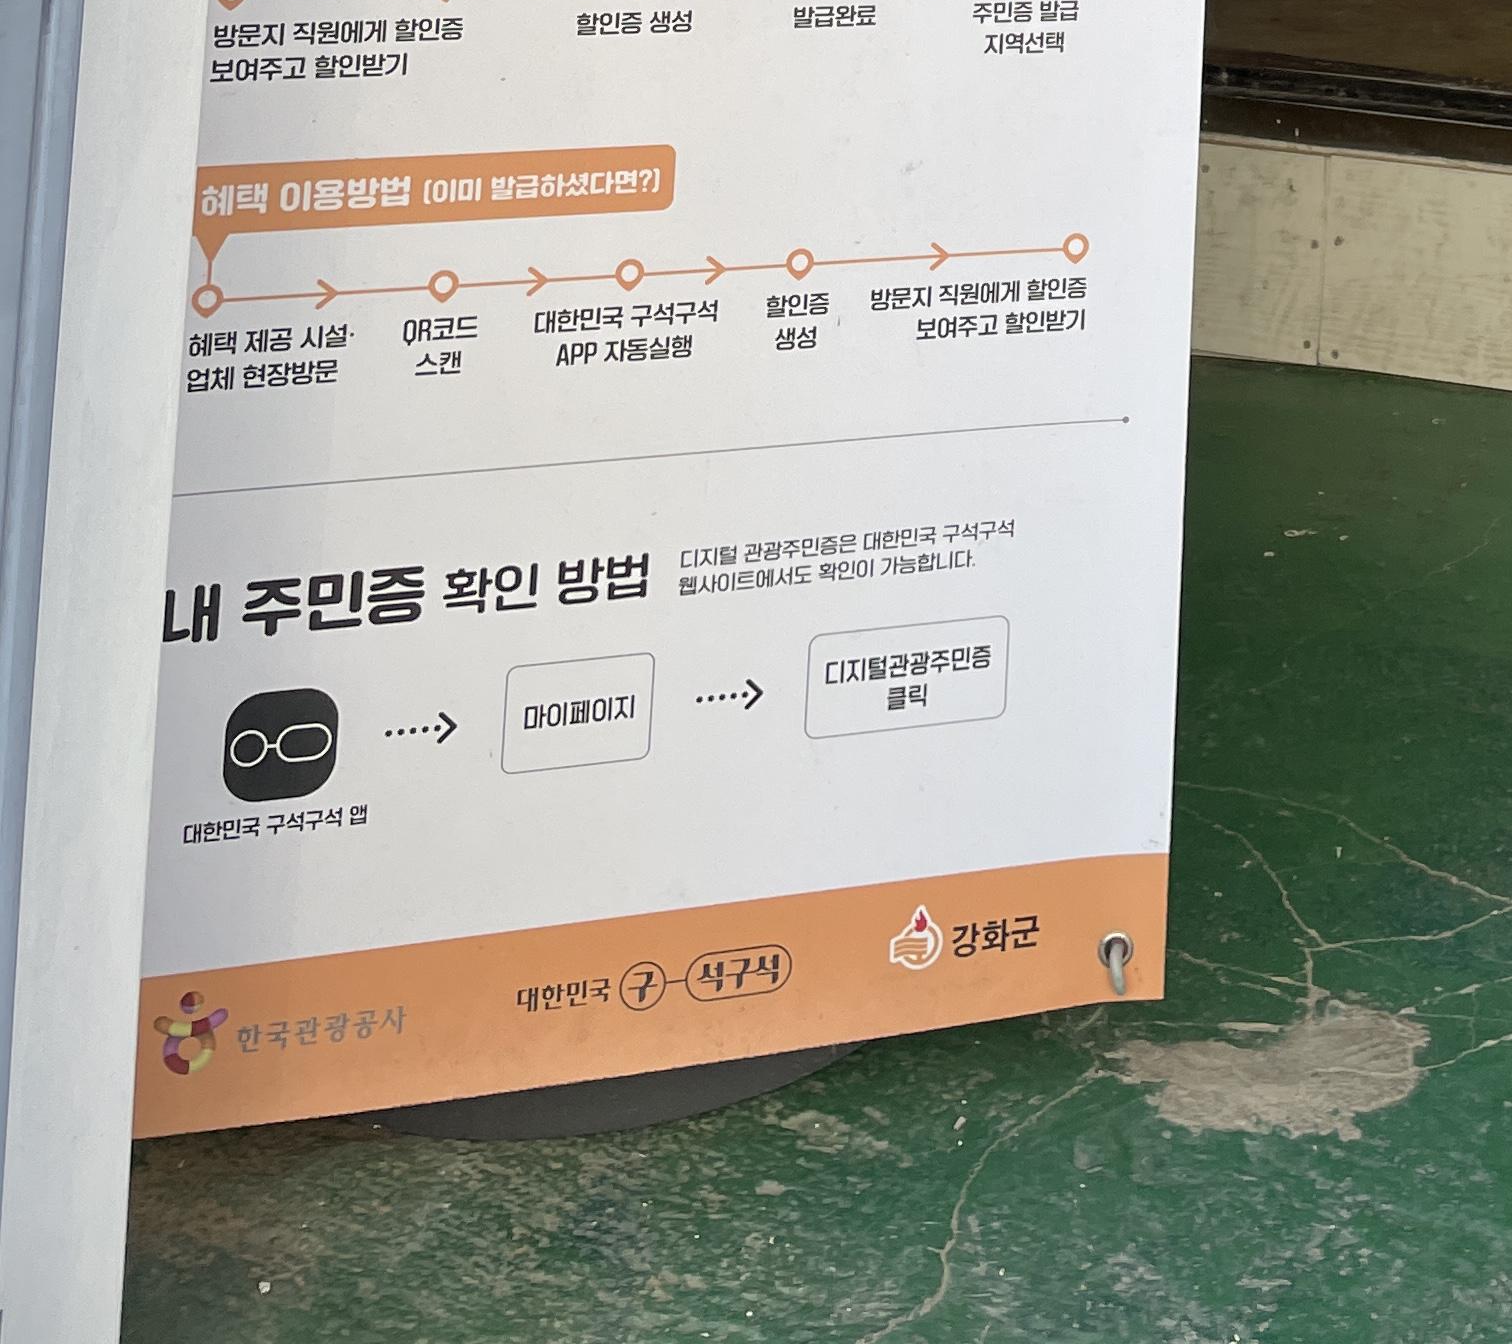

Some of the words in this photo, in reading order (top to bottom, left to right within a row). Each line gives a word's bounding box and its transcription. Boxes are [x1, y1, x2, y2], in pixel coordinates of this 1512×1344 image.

[576, 12, 642, 37] 할인증
[650, 9, 693, 33] 생성
[793, 5, 877, 29] 발급완료
[973, 1, 1033, 23] 주민증
[1039, 0, 1079, 23] 발급
[213, 23, 285, 48] 방문지
[293, 20, 387, 46] 직원에게
[395, 17, 464, 42] 할인증
[984, 32, 1065, 55] 지역선택
[210, 56, 306, 82] 보여주고
[314, 53, 408, 79] 할인받기
[202, 183, 268, 217] 혜택
[279, 176, 410, 212] 이용방법
[766, 292, 830, 318] 할인증
[870, 286, 932, 311] 방문지
[939, 280, 1020, 306] 직원에게
[1027, 277, 1087, 300] 할인증
[402, 315, 478, 346] QR코드
[534, 307, 624, 334] 대한민국
[630, 300, 719, 328] 구석구석
[916, 316, 997, 341] 보여주고
[1005, 309, 1086, 335] 할인받기
[189, 332, 237, 357] 혜택
[244, 328, 293, 353] 제공
[556, 342, 596, 367] APP
[604, 335, 693, 362] 자동실행
[775, 326, 817, 351] 생성
[186, 367, 234, 392] 업체
[243, 360, 338, 389] 현장방문
[414, 351, 462, 377] 스캔
[680, 548, 737, 569] 디지털
[743, 534, 857, 563] 관광주민증은
[863, 528, 937, 551] 대한민국
[942, 519, 1015, 544] 구석구석
[679, 568, 812, 596] 웹사이트에서도
[818, 558, 875, 581] 확인이
[880, 550, 976, 577] 가능합니다.
[163, 583, 220, 642] 내
[242, 566, 424, 636] 주민증
[443, 562, 538, 613] 확인
[558, 553, 649, 605] 방법
[825, 645, 991, 685] 디지털관광주민증
[524, 695, 635, 730] 마이페이지
[887, 685, 927, 710] 클릭
[183, 817, 260, 843] 대한민국
[266, 809, 343, 835] 구석구석
[350, 805, 367, 824] 앱
[951, 915, 1040, 959] 강화군
[516, 978, 611, 1012] 대한민국
[237, 1005, 407, 1054] 한국관광공사
